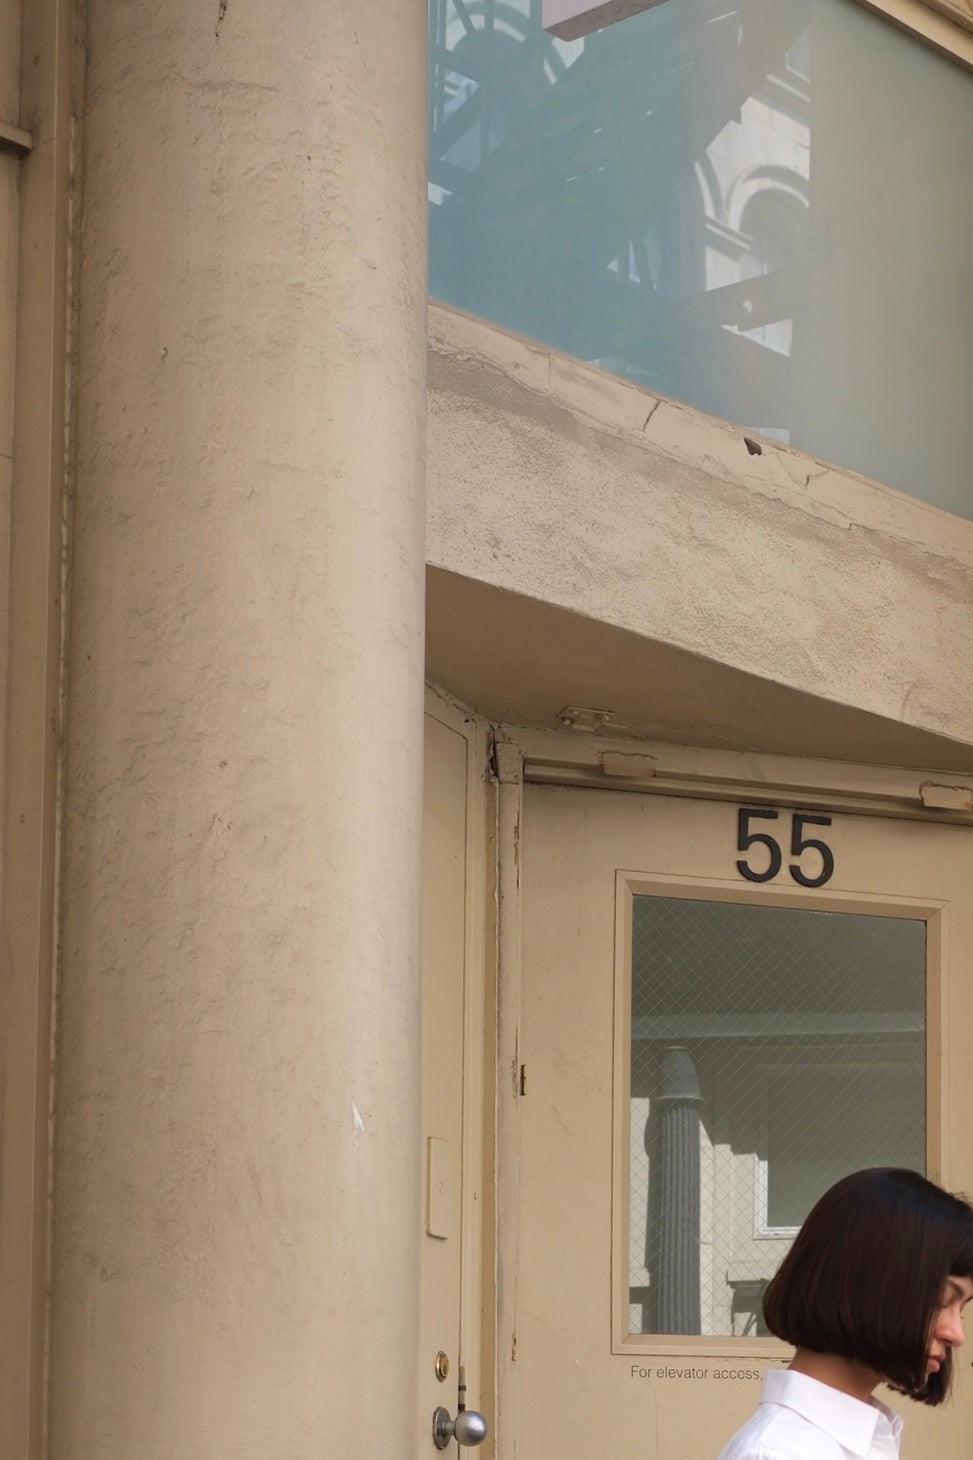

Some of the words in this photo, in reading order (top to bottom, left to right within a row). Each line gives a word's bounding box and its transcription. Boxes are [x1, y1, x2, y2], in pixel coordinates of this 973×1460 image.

[736, 807, 834, 888] 55
[630, 1365, 652, 1378] For
[656, 1366, 709, 1379] elevator
